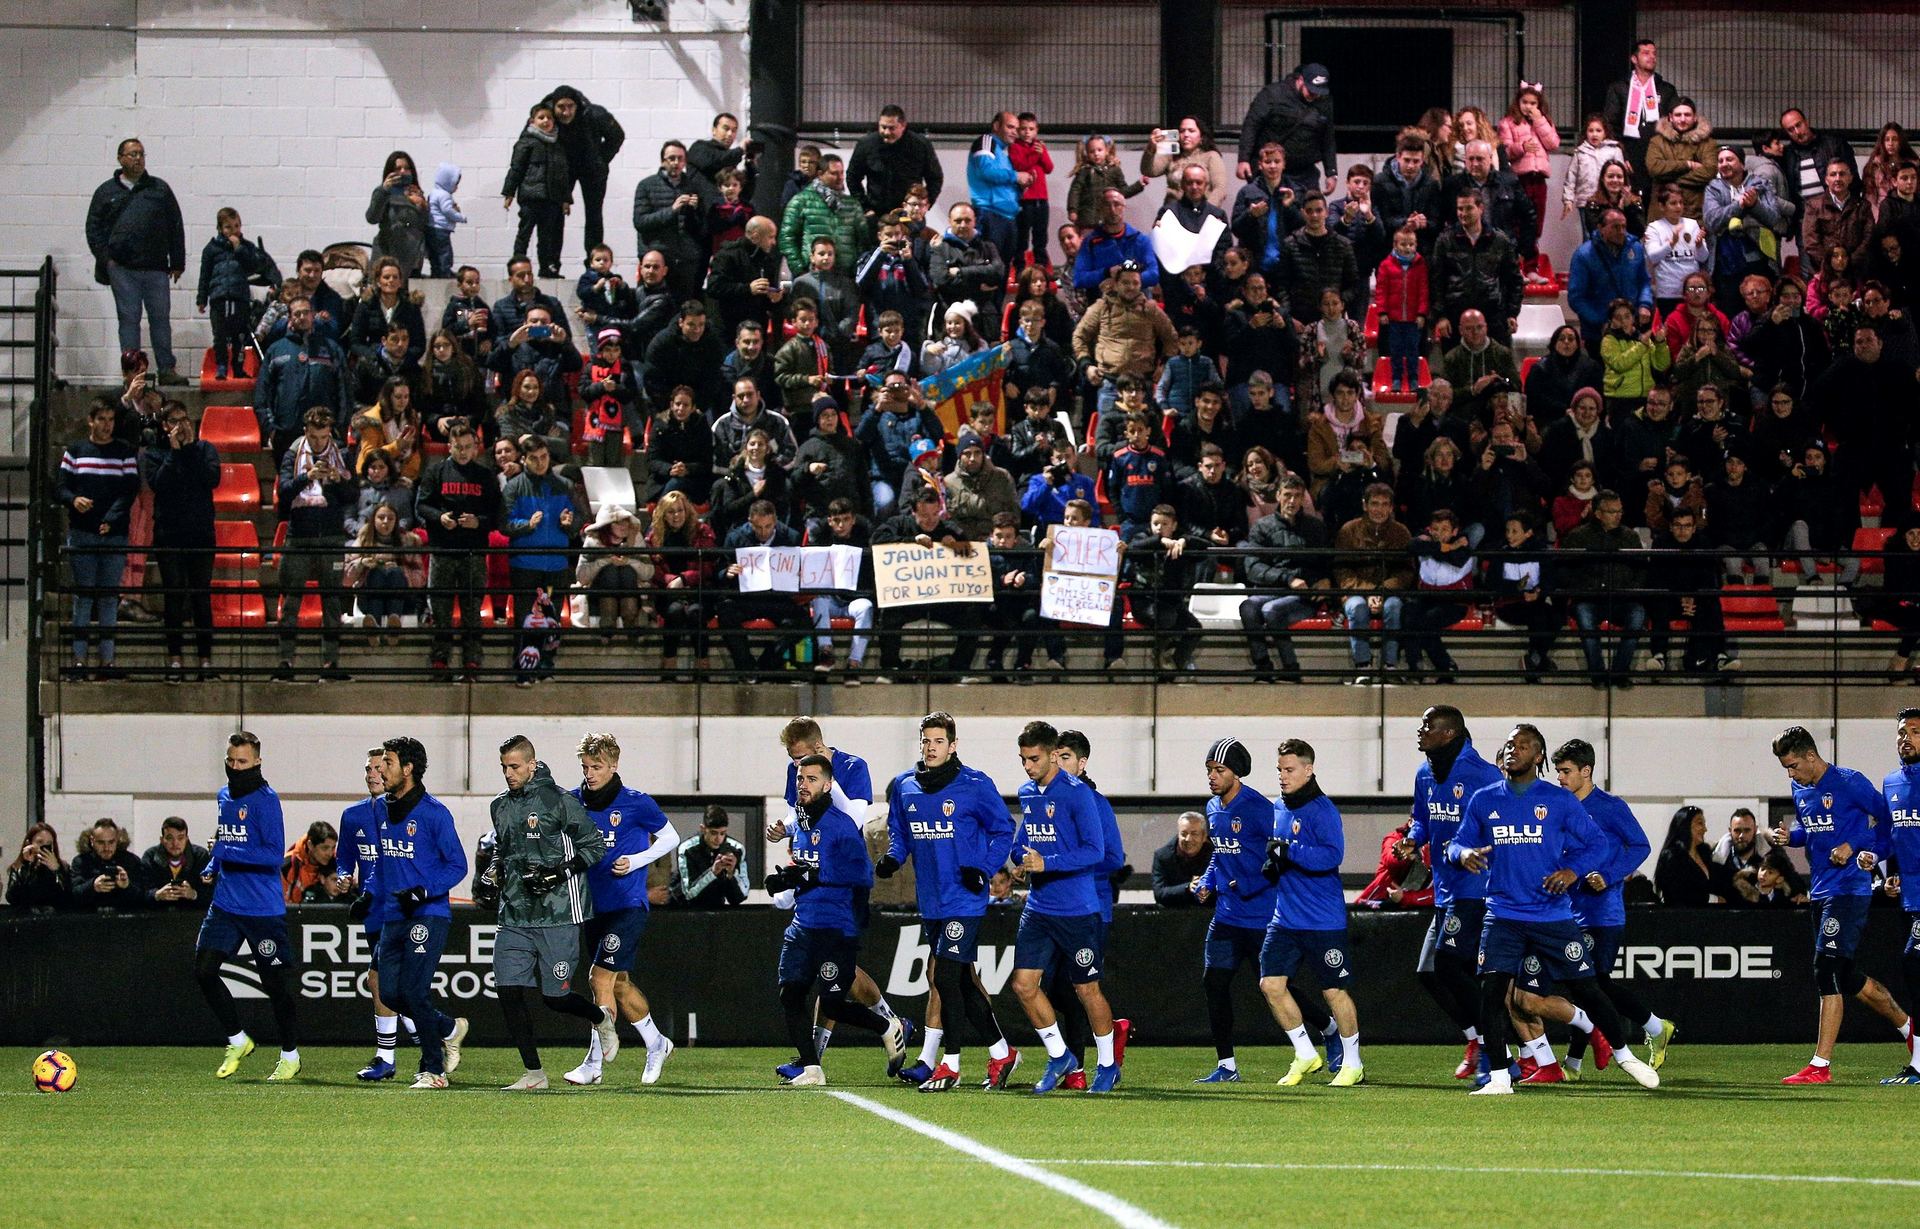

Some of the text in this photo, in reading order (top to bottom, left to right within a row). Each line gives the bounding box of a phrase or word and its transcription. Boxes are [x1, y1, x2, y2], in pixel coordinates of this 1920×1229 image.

[441, 481, 481, 496] ADIDAS
[1056, 530, 1113, 566] SOLER
[800, 550, 856, 585] GAA
[894, 564, 987, 582] GUANTES
[883, 583, 990, 600] POR LOS TUYOS
[1428, 802, 1460, 815] BLU
[910, 820, 954, 832] BLU
[1802, 814, 1833, 827] BLU
[1025, 823, 1056, 835] BLU
[1492, 825, 1543, 837] BLU
[381, 839, 414, 852] BLU
[1494, 836, 1543, 845] smartphones
[358, 844, 378, 855] BL
